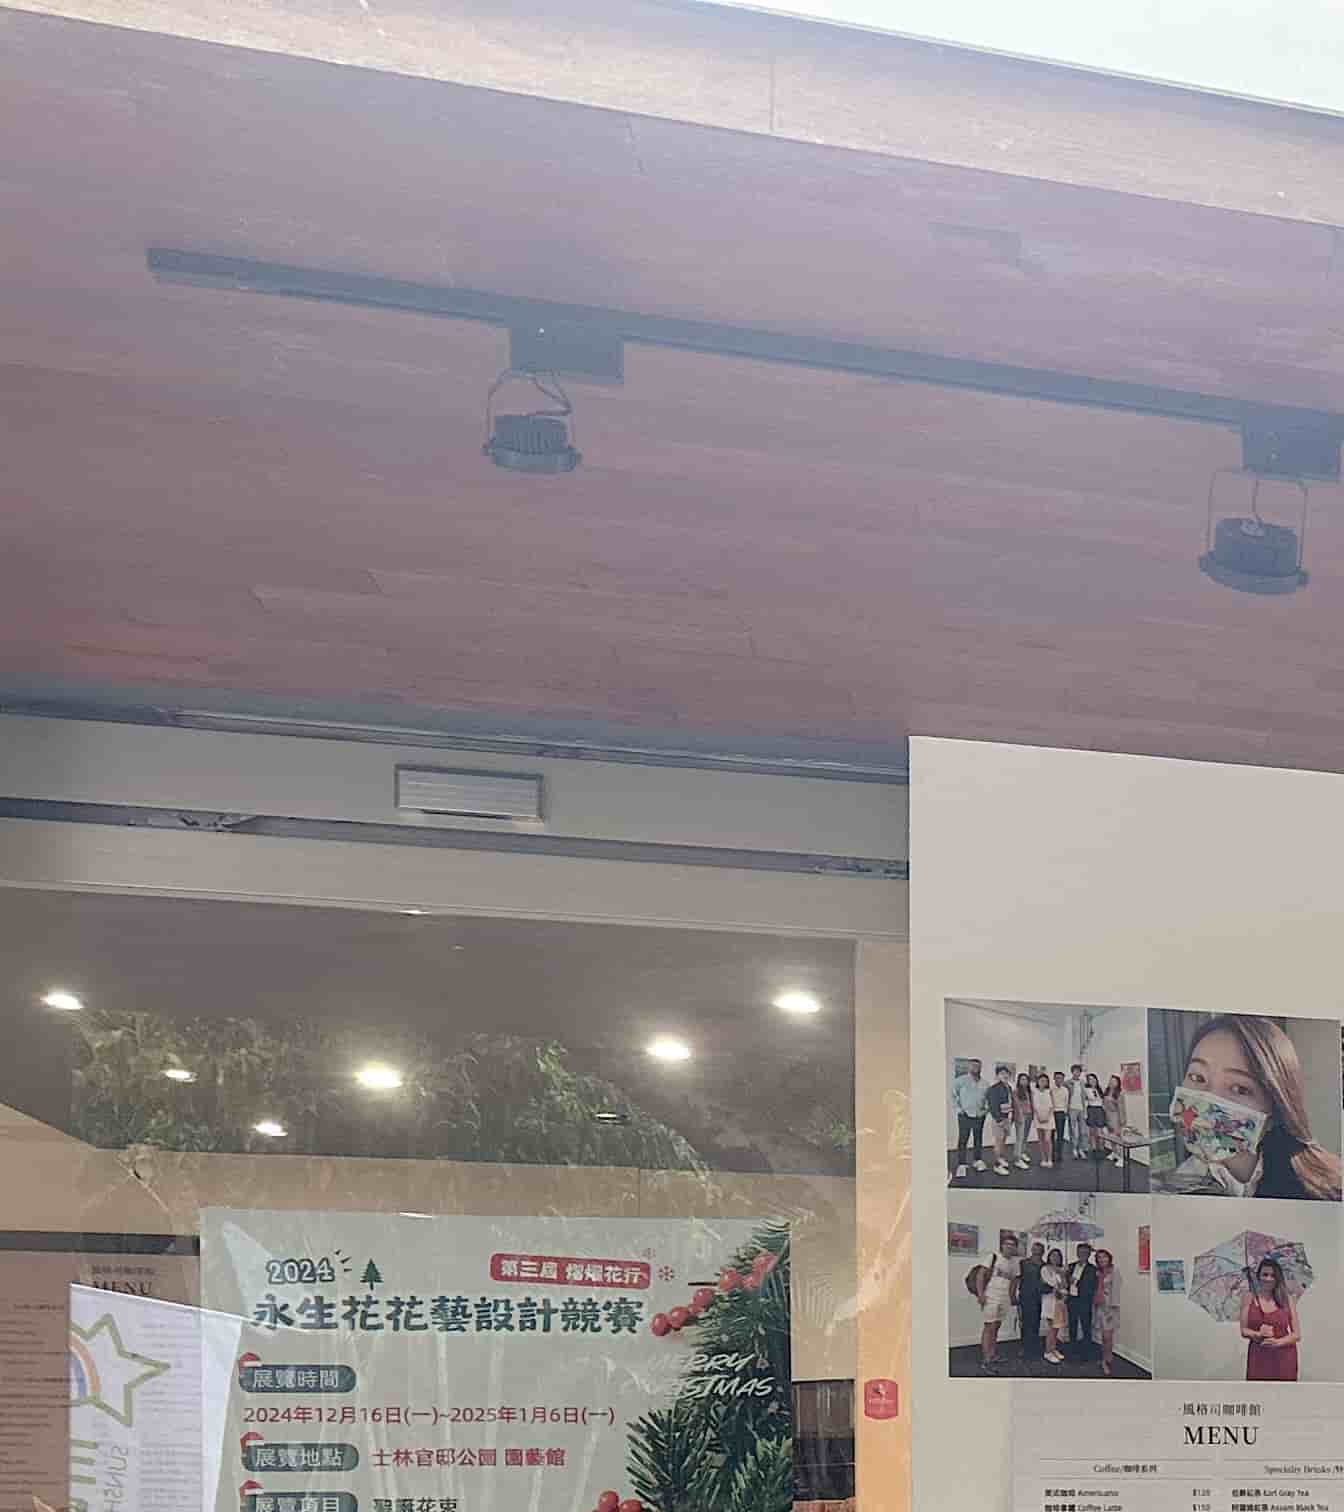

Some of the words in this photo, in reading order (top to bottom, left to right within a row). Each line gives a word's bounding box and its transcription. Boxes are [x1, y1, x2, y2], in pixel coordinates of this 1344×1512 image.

[266, 1258, 334, 1285] 2024
[252, 1293, 644, 1336] 永生花花藝設計競賽
[252, 1368, 340, 1390] 展覽時間
[242, 1405, 616, 1427] 2024年12月16日(一)~2025年1月6日(一)
[1183, 1425, 1260, 1446] MENU
[254, 1447, 345, 1469] 展覽地點
